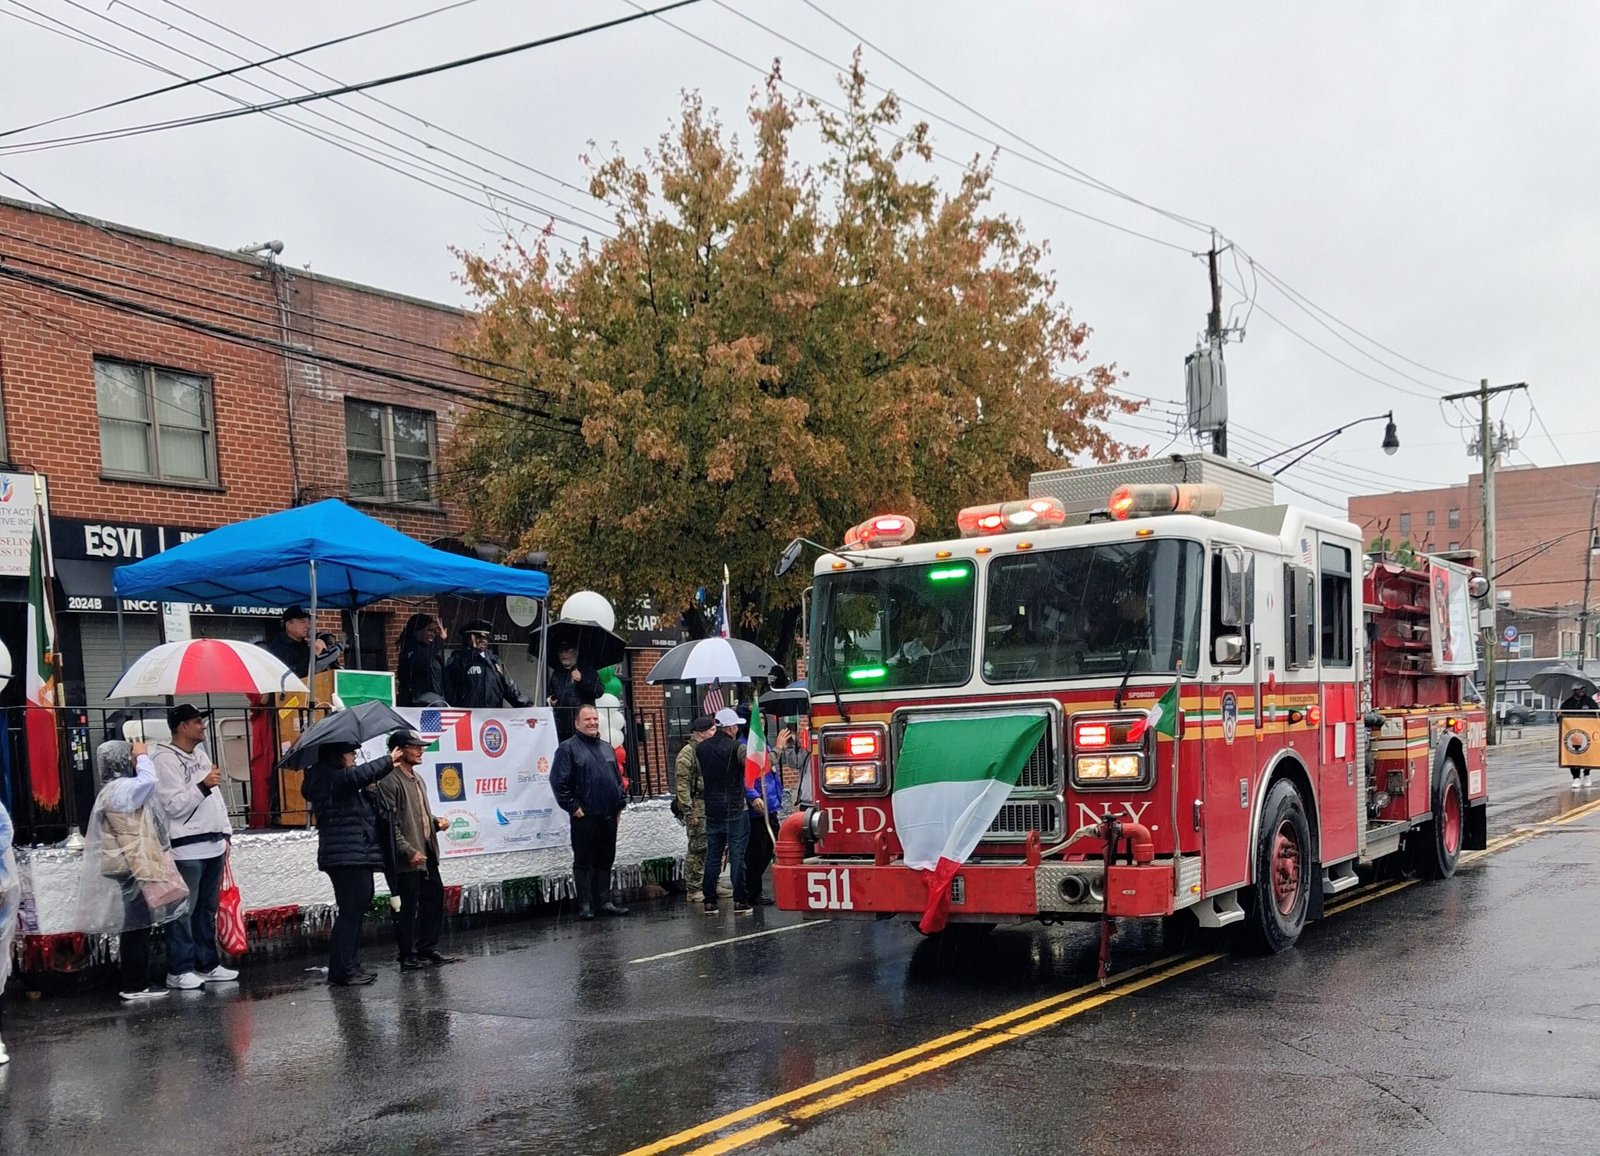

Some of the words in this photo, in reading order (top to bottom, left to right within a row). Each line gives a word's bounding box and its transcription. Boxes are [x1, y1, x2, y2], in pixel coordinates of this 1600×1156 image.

[84, 525, 143, 558] ESVI
[68, 596, 102, 610] 2024B
[475, 777, 508, 794] TEITEL
[825, 806, 893, 834] F.D.
[807, 868, 854, 910] 511
